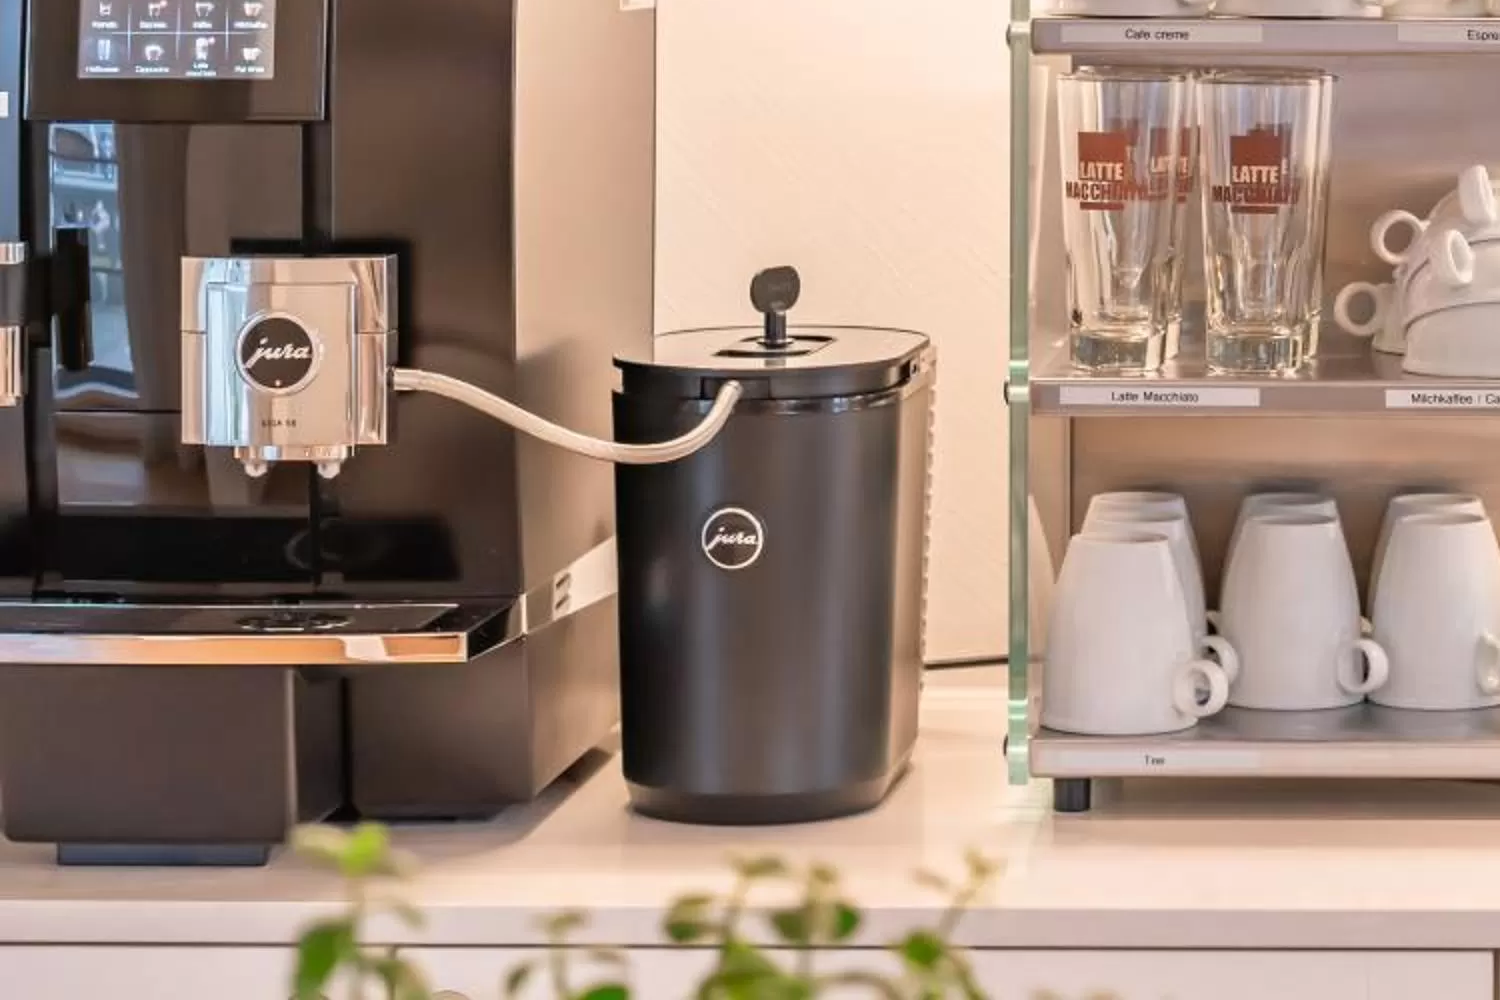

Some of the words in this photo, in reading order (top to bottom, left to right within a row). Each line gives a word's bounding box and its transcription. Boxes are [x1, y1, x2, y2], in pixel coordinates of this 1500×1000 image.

[1079, 160, 1125, 181] LATTE
[1231, 164, 1280, 183] LATTE
[244, 336, 312, 369] jura
[706, 526, 758, 551] jura
